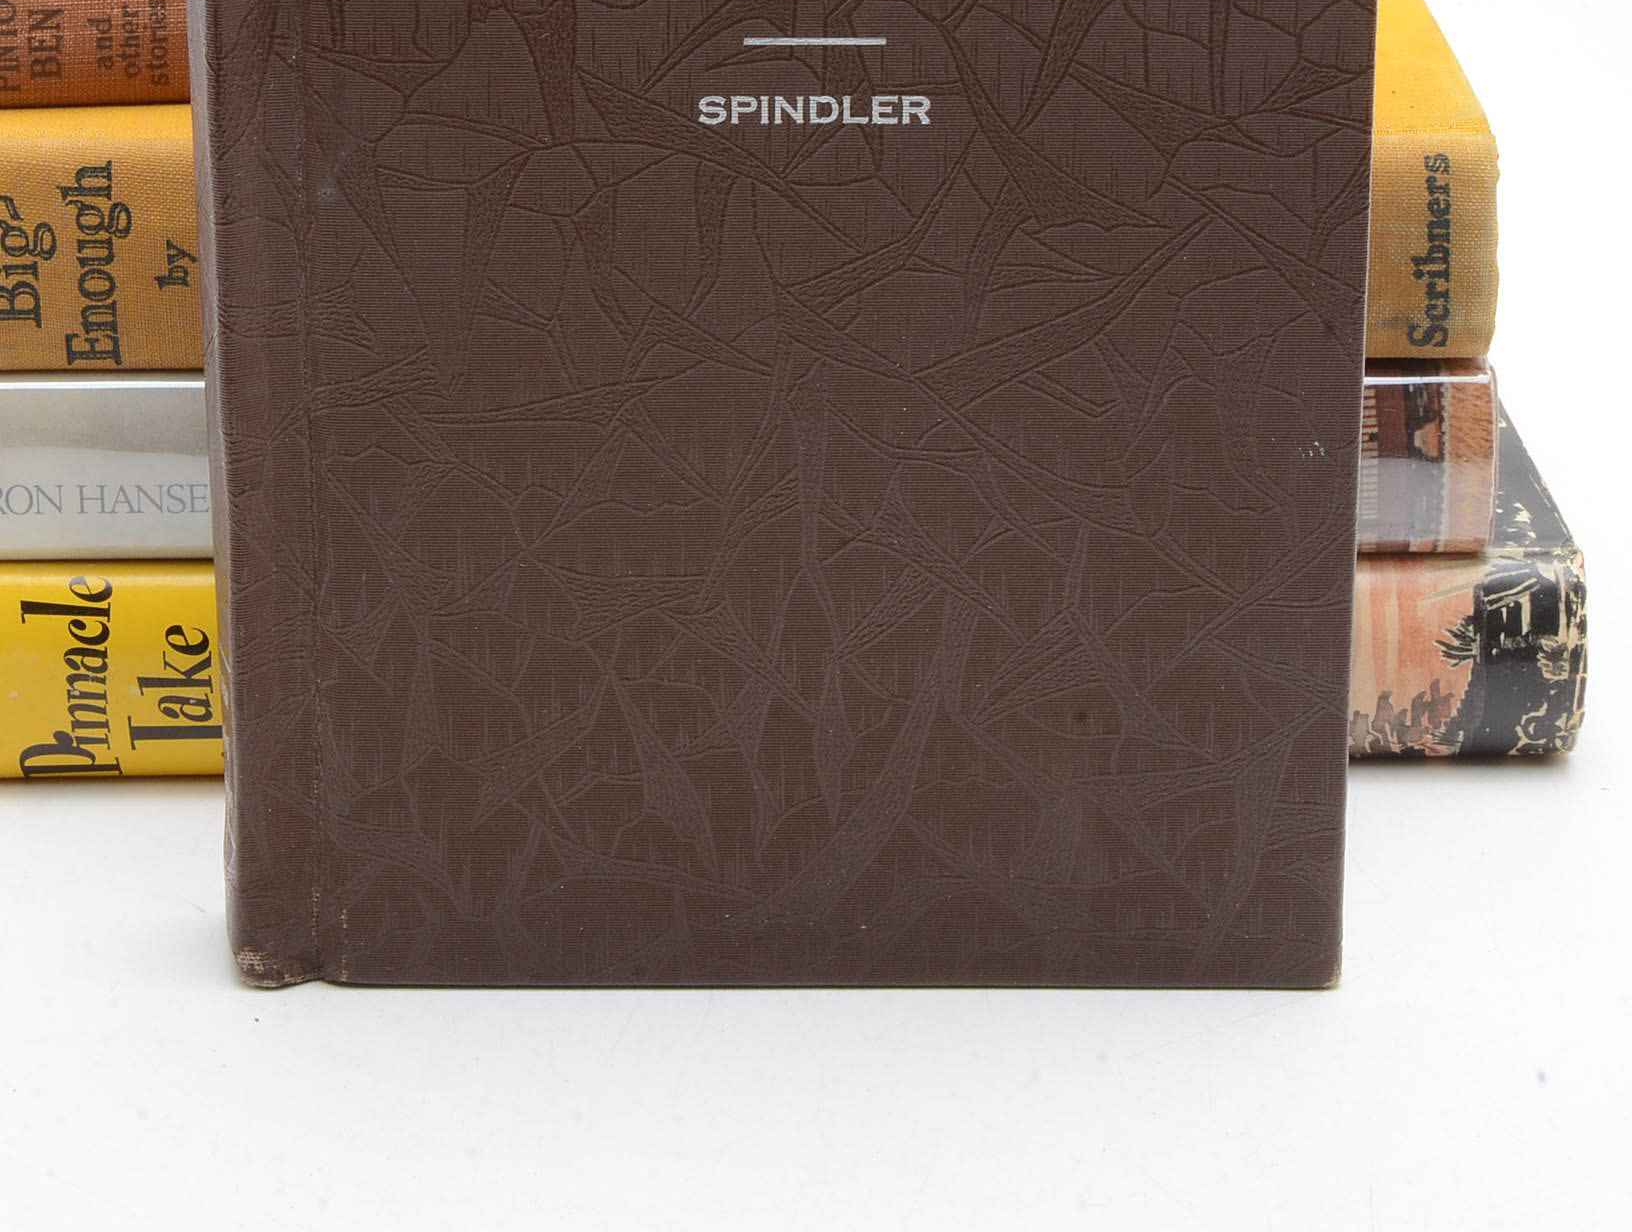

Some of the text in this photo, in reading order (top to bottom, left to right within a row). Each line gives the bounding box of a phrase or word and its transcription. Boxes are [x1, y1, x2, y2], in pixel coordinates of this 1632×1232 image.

[28, 9, 64, 80] BEN
[88, 15, 114, 69] and
[119, 1, 140, 78] other
[698, 95, 931, 125] SPINDLER
[56, 160, 132, 366] Enough
[154, 239, 199, 290] by
[1407, 153, 1451, 347] Scribners
[19, 576, 123, 777] Pinnacle
[127, 625, 224, 757] Jake
